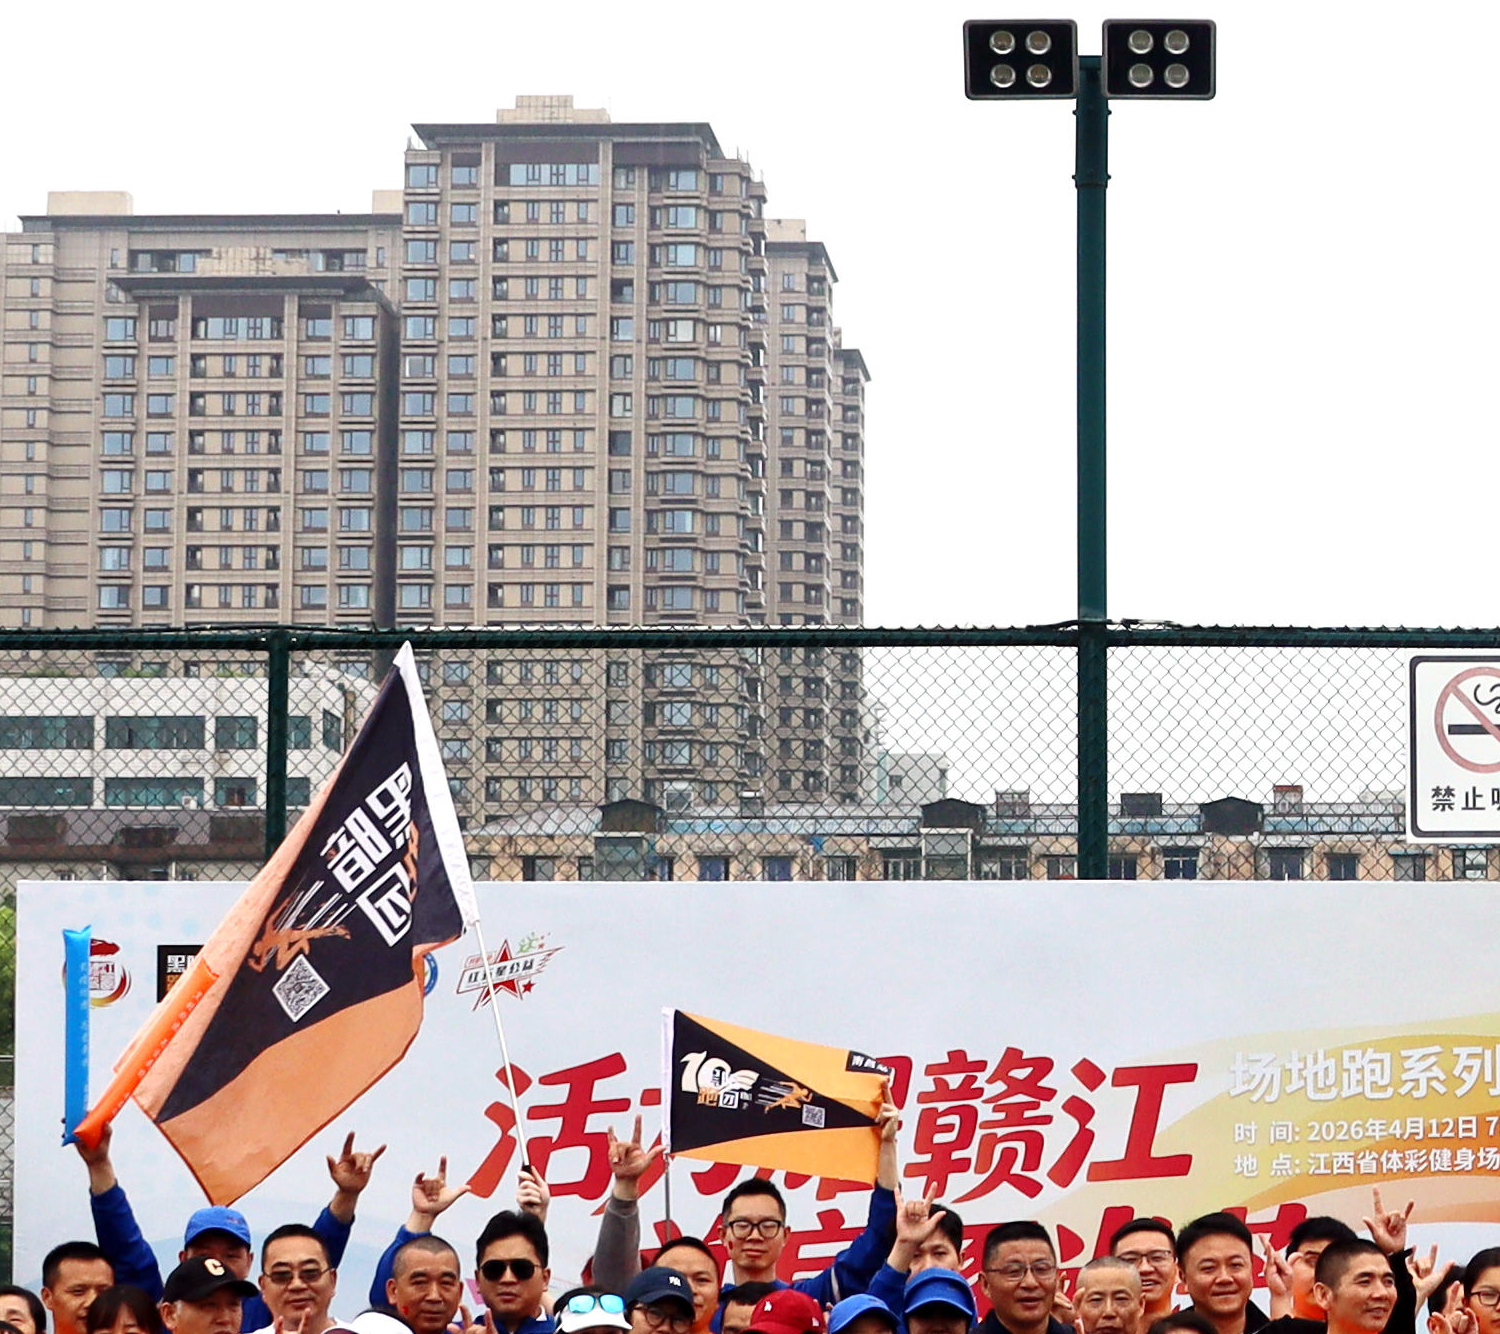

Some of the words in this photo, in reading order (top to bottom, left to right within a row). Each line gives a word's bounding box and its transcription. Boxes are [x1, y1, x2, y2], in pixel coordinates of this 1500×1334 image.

[465, 1047, 1198, 1204] 活赣江
[1307, 1116, 1478, 1142] 2026年4月12日
[204, 1259, 224, 1277] C
